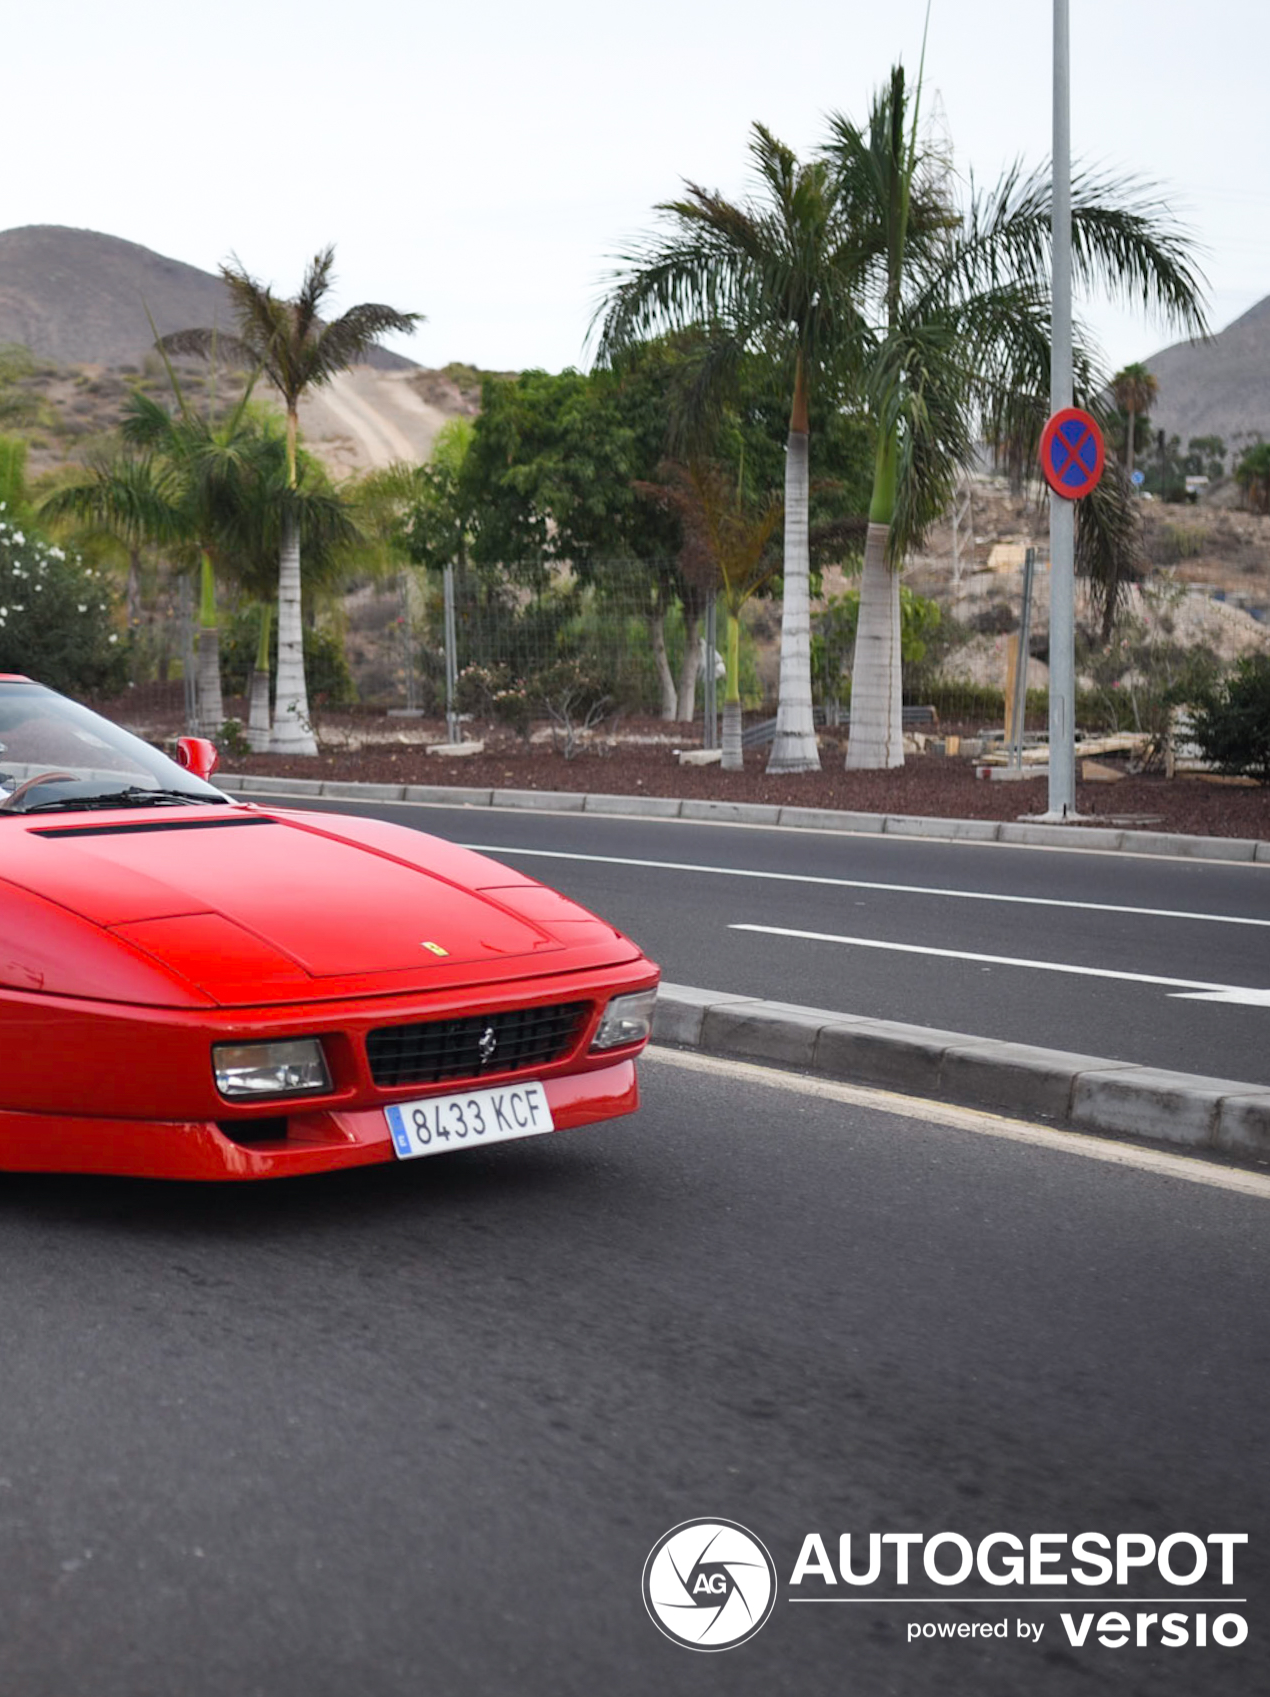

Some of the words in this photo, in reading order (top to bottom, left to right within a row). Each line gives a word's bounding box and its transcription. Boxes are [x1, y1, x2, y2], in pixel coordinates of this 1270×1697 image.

[398, 1135, 407, 1147] E
[412, 1099, 486, 1145] 8433
[491, 1089, 539, 1132] KCF
